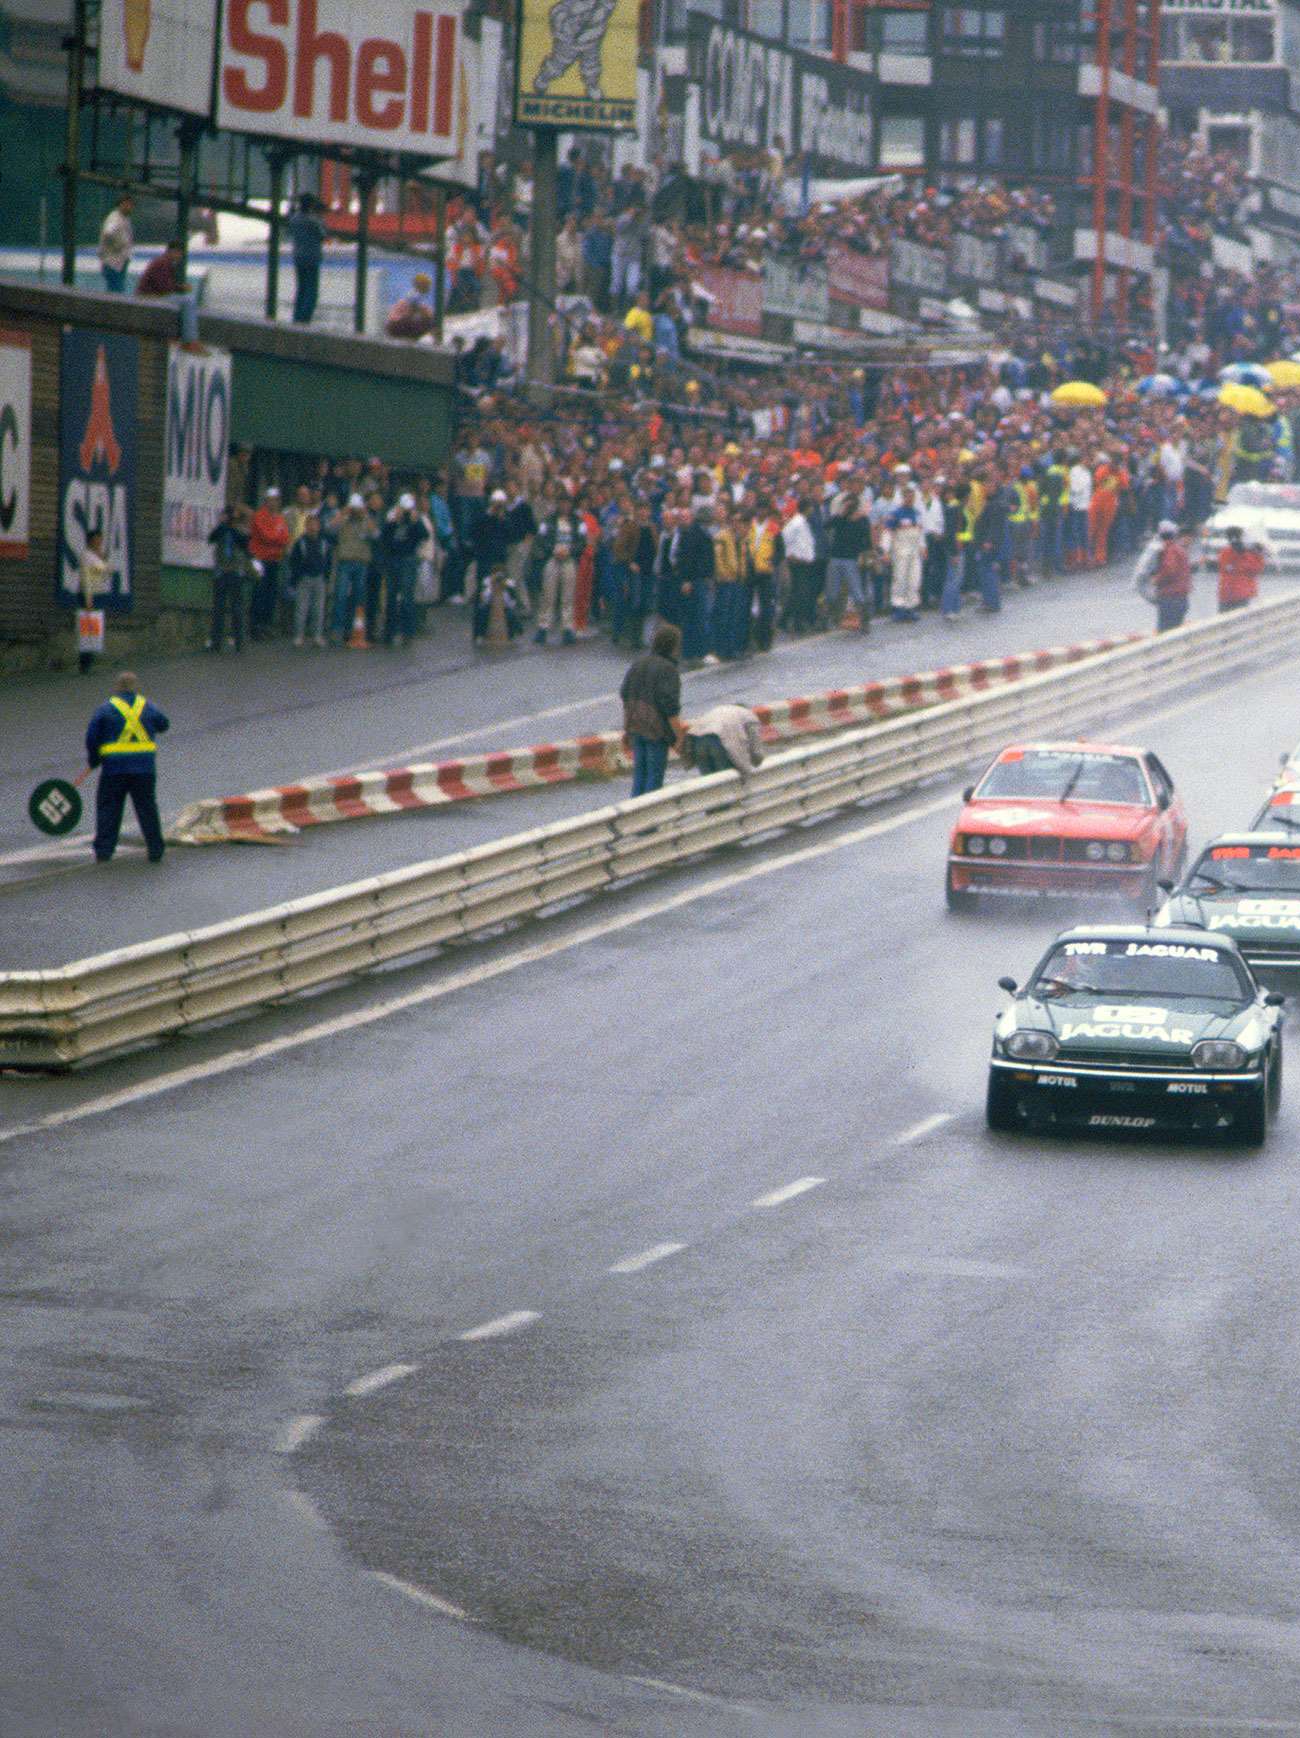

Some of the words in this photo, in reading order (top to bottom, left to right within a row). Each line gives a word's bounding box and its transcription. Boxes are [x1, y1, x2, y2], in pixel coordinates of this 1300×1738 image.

[223, 0, 456, 137] Shell
[524, 102, 634, 119] MICHELIN
[1063, 943, 1107, 956] TWR
[1125, 943, 1219, 963] JAGUAR
[1059, 1023, 1195, 1045] JAGUAR
[1036, 1074, 1078, 1088] MOTUL
[1166, 1082, 1209, 1094] MOTUL
[1088, 1115, 1156, 1128] DUNLOP
